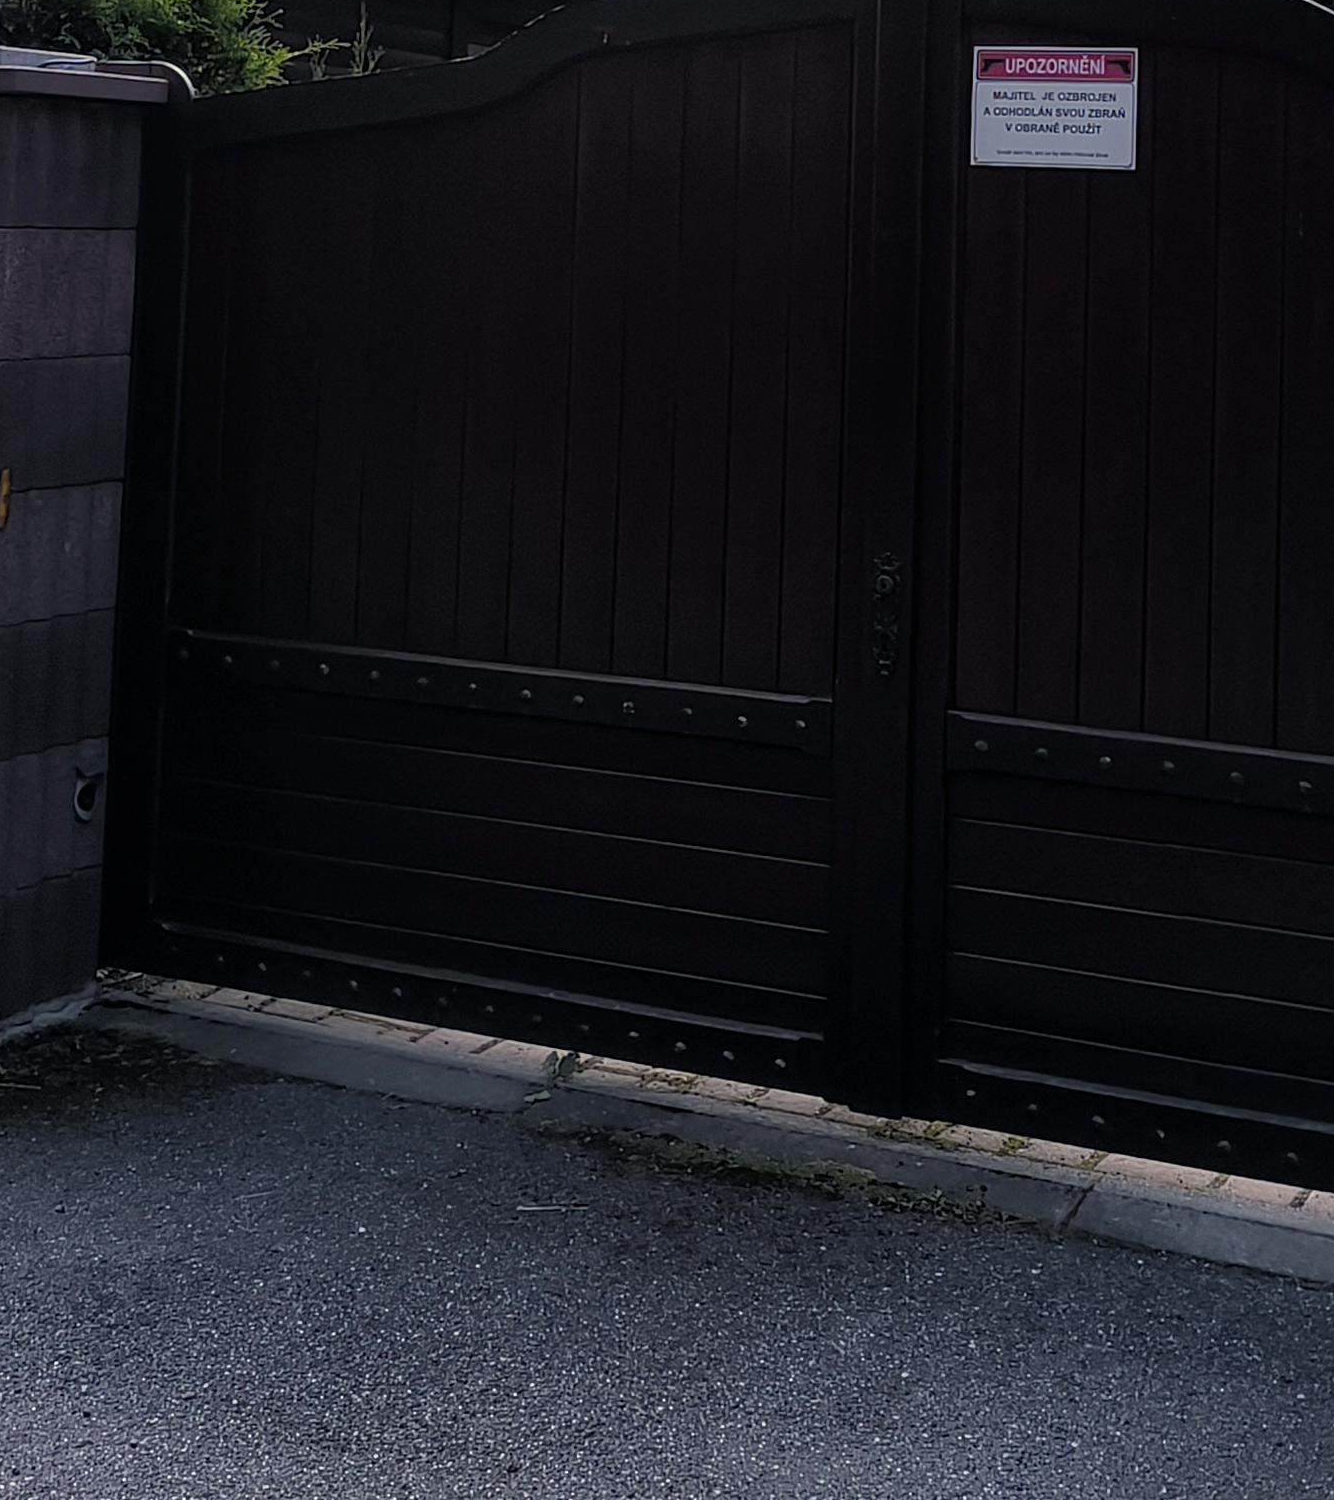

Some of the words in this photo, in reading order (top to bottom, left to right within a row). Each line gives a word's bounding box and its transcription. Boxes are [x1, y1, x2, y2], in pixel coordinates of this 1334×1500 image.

[1005, 55, 1105, 75] UPOZORNĚNÍ
[993, 91, 1036, 101] MAJITEL
[1041, 92, 1055, 101] JE
[1057, 92, 1117, 102] OZBROJEN
[983, 106, 991, 116] A
[993, 105, 1053, 117] ODHODLÁN
[1056, 108, 1085, 117] SVOU
[1088, 107, 1126, 118] ZBRAŇ
[1005, 122, 1013, 132] V
[1063, 123, 1102, 135] POUŽÍT
